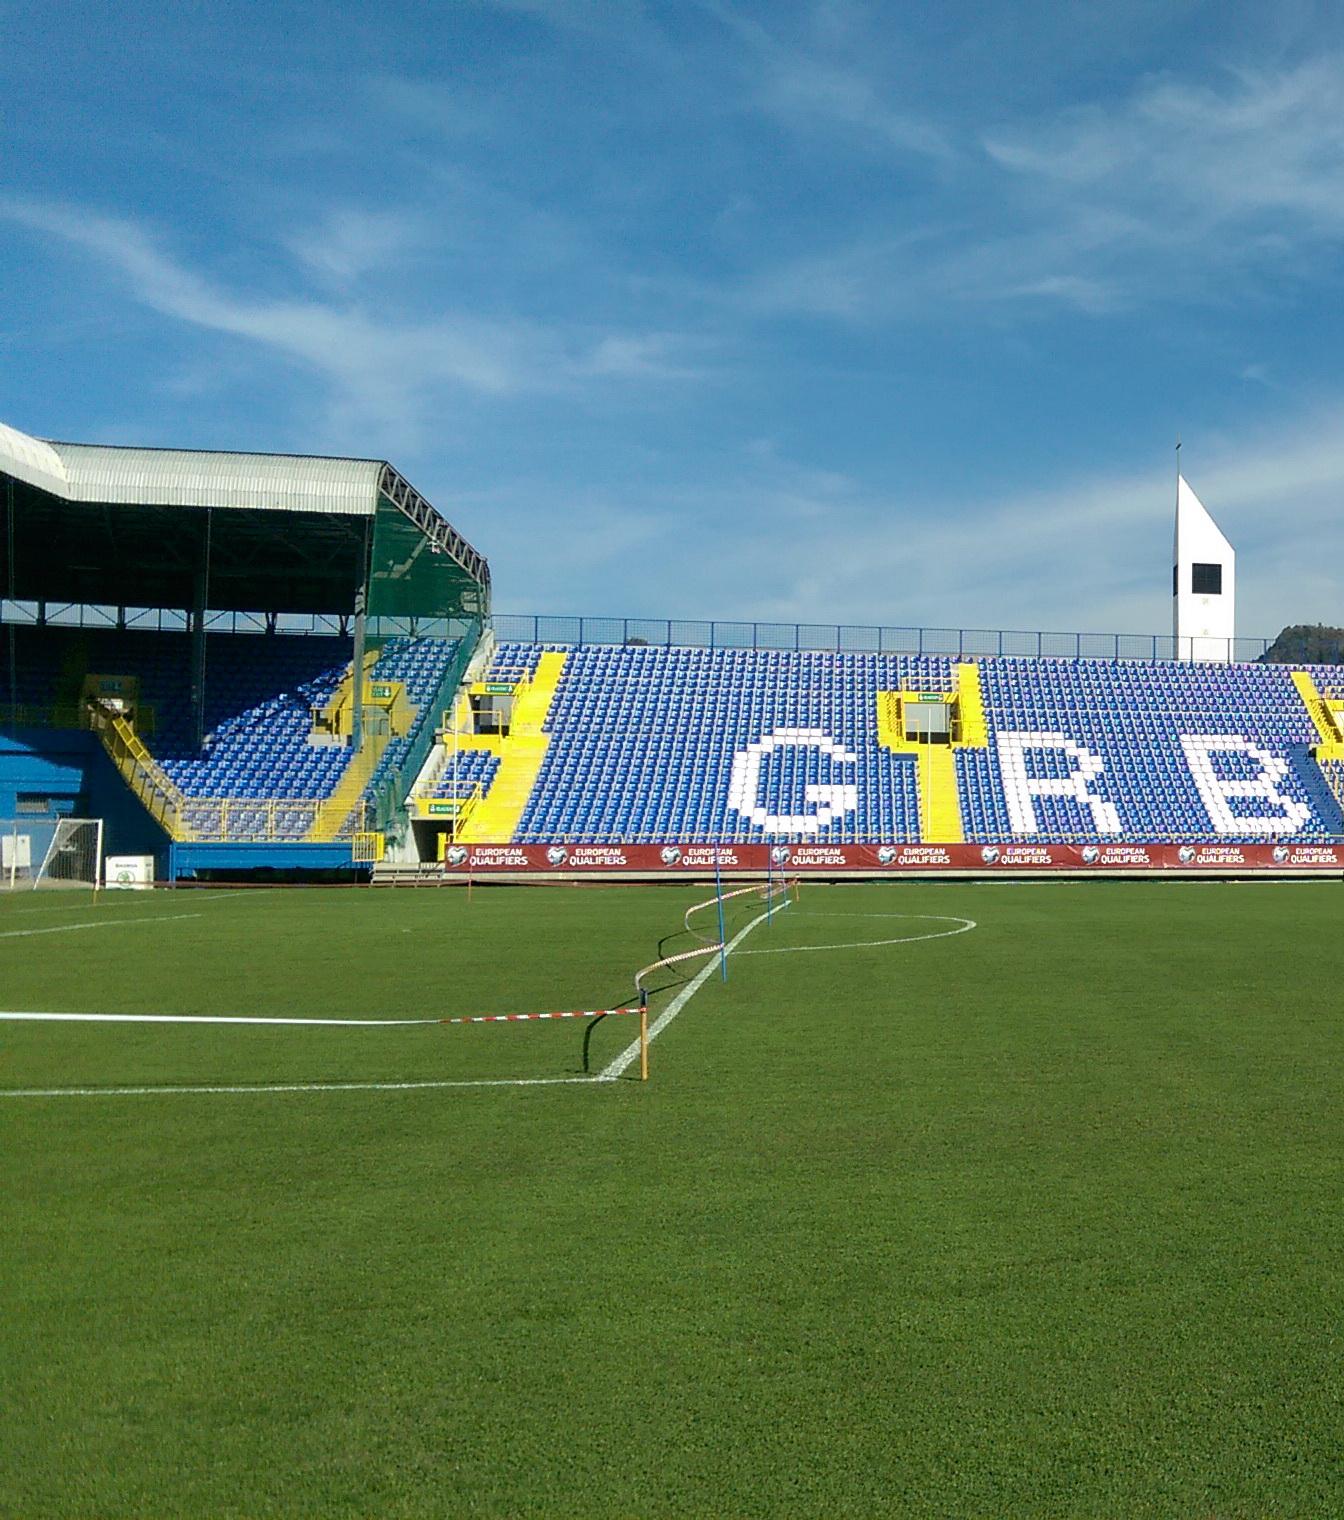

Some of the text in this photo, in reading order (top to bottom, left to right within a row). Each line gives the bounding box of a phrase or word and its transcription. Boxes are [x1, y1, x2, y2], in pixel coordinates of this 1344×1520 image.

[475, 848, 524, 857] EUROPEAN
[575, 848, 622, 857] EUROPEAN
[688, 848, 734, 856] EUROPEAN
[798, 848, 841, 856] EUROPEAN
[903, 847, 946, 856] EUROPEAN
[1006, 847, 1048, 856] EUROPEAN
[1106, 847, 1145, 855] EUROPEAN
[1202, 847, 1241, 855] EUROPEAN
[1295, 847, 1334, 855] EUROPEAN
[469, 856, 529, 866] QUALIFIERS
[569, 856, 628, 866] QUALIFIERS
[682, 855, 739, 866] QUALIFIERS
[791, 855, 847, 866] QUALIFIERS
[897, 855, 951, 865] QUALIFIERS
[1000, 855, 1053, 865] QUALIFIERS
[1101, 854, 1151, 865] QUALIFIERS
[1196, 854, 1245, 864] QUALIFIERS
[1290, 854, 1338, 864] QUALIFIERS
